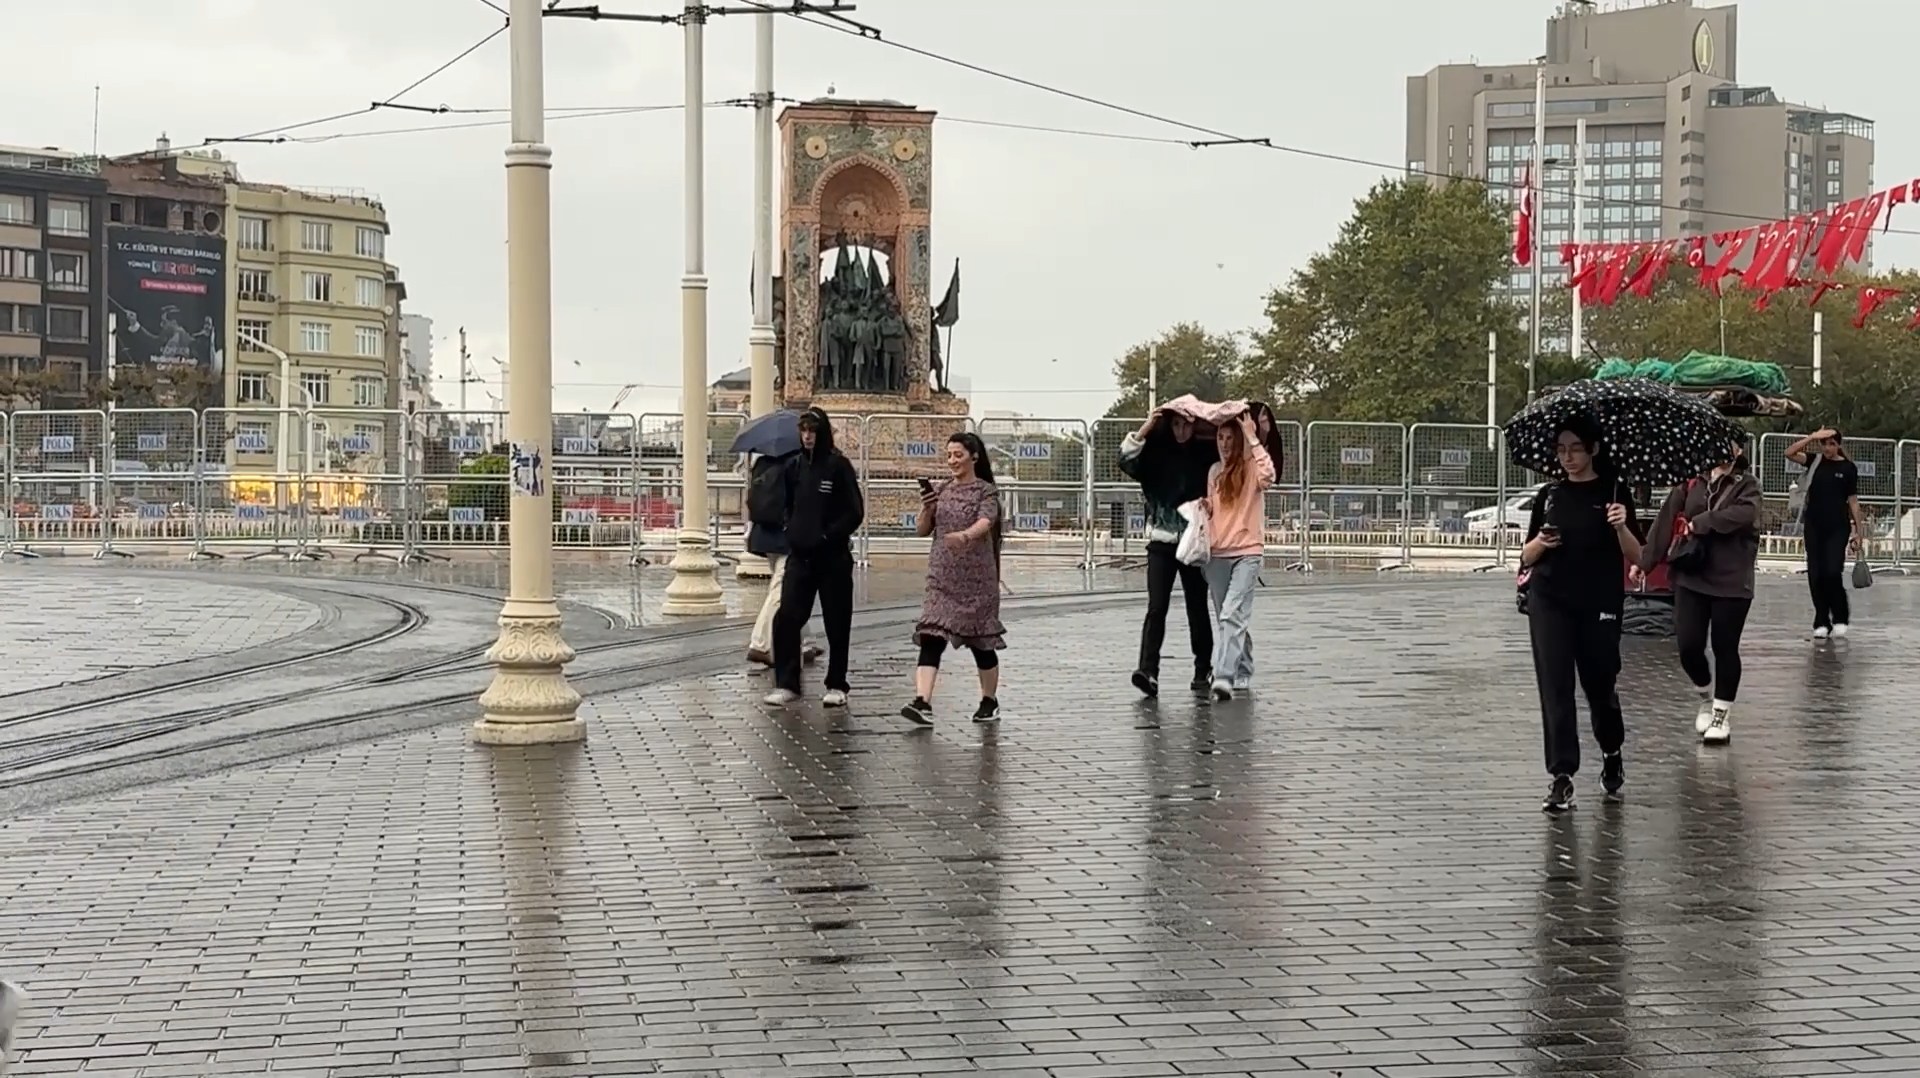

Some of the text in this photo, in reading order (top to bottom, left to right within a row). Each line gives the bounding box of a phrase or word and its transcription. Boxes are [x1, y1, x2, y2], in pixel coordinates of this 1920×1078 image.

[117, 243, 131, 251] T.C.
[132, 243, 158, 253] KÜLTÜR
[160, 246, 168, 255] VE
[46, 437, 72, 451] POLİS
[140, 435, 164, 448] POLİS
[239, 435, 266, 448] POLİS
[343, 437, 370, 450] POLİS
[452, 437, 481, 450] POLİS
[907, 442, 936, 455] POLİS
[1019, 444, 1048, 457] POLİS
[1344, 448, 1370, 462] POLİS
[1444, 449, 1468, 463] POLİS
[140, 505, 165, 518] POLİS
[238, 505, 265, 518] POLİS
[343, 507, 370, 520] POLİS
[452, 508, 481, 521] POLİS
[1018, 514, 1048, 528] POLİS
